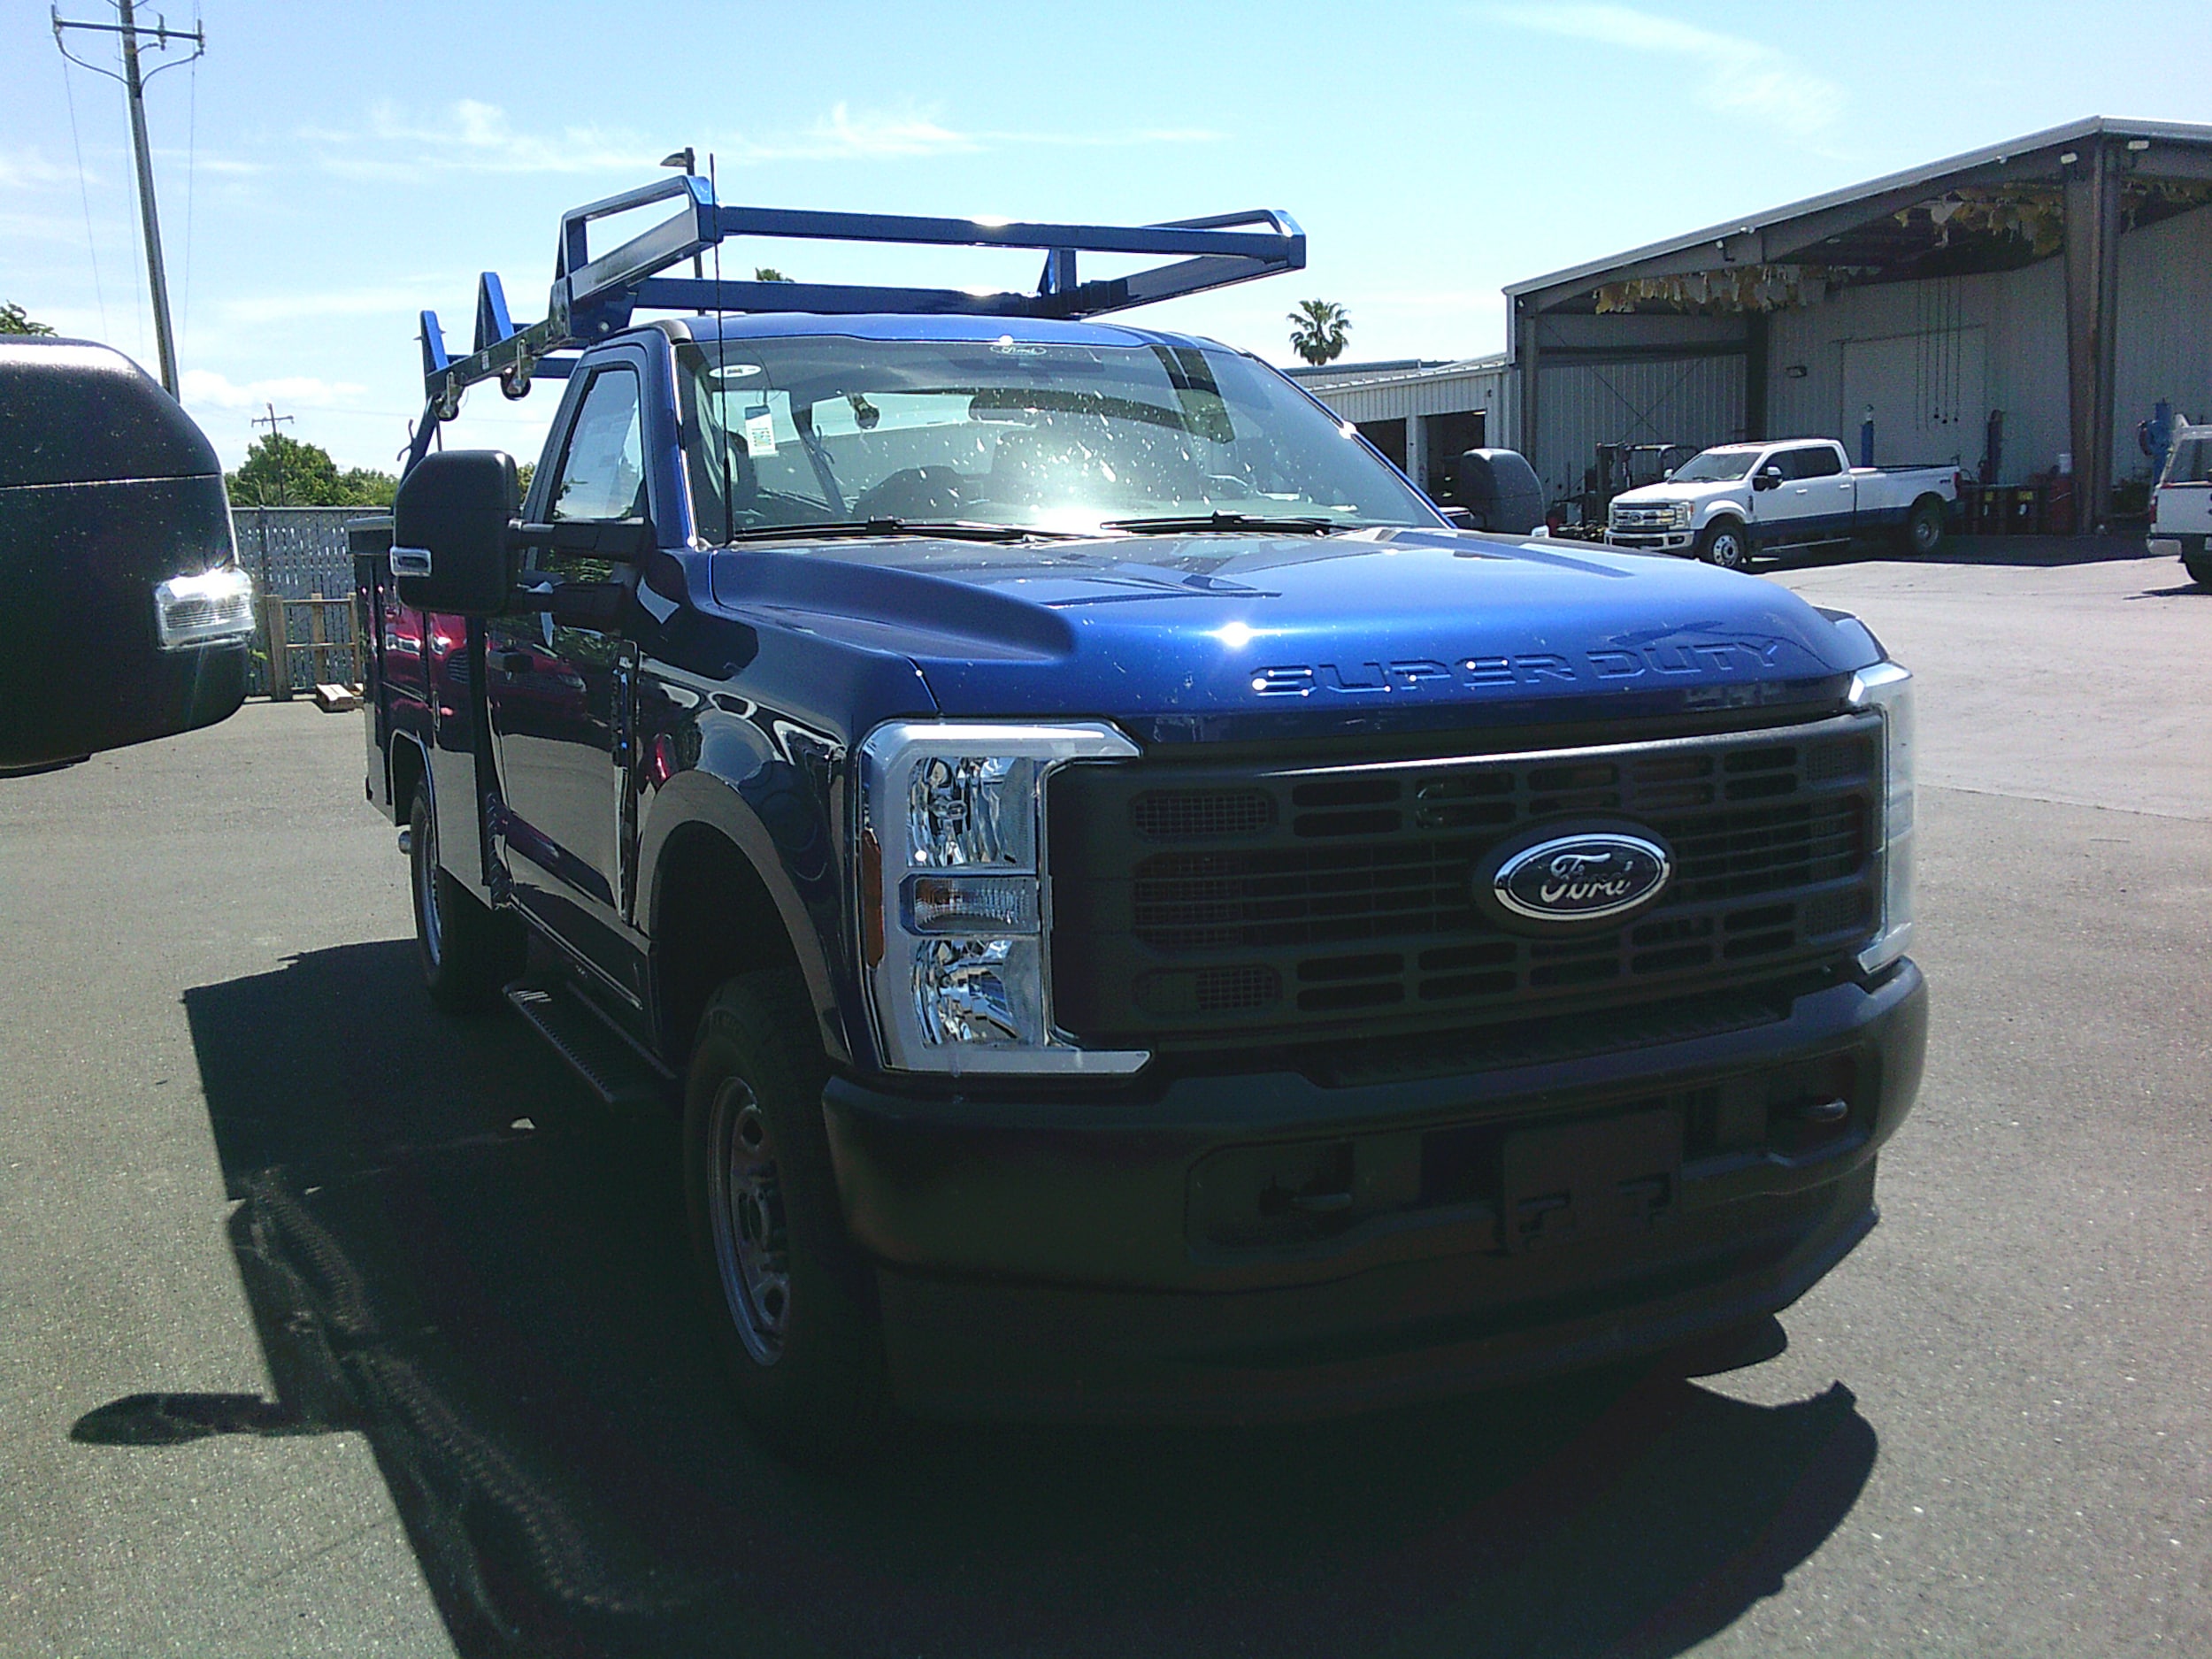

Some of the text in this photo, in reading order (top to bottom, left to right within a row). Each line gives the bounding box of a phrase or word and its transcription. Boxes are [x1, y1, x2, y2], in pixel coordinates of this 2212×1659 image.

[1250, 640, 1778, 697] SUPER DUTY
[1540, 852, 1634, 903] Ford
